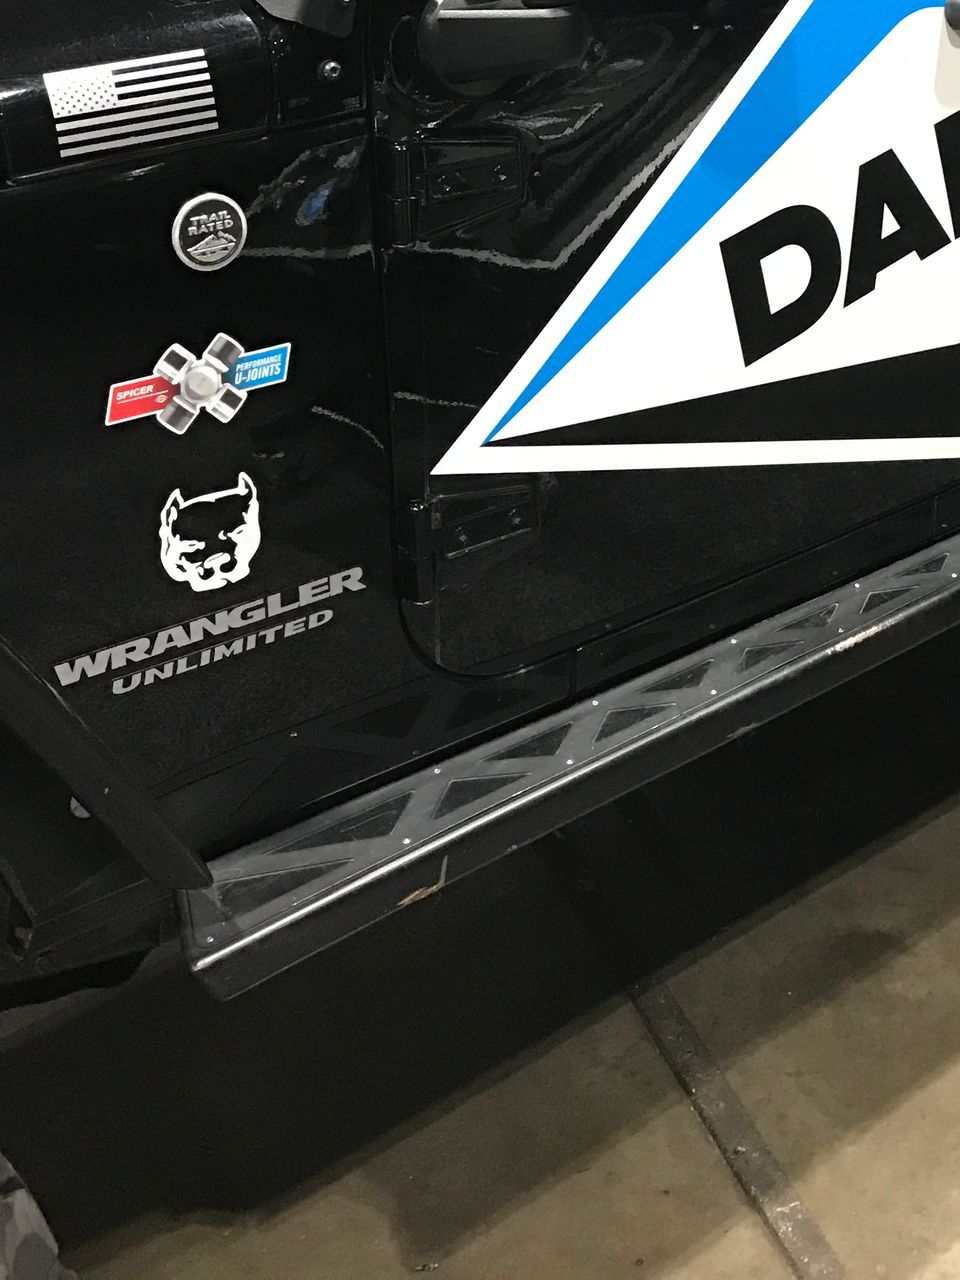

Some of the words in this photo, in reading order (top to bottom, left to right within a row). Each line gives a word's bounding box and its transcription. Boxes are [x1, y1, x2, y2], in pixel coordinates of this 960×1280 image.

[190, 210, 231, 226] TRAIL
[188, 219, 234, 236] RATED
[236, 354, 282, 372] PERFORMANCE
[235, 363, 281, 385] U-JOINTS
[116, 384, 155, 400] SPICER
[53, 567, 367, 687] WRANGLER
[112, 609, 335, 695] UNLIMITED
